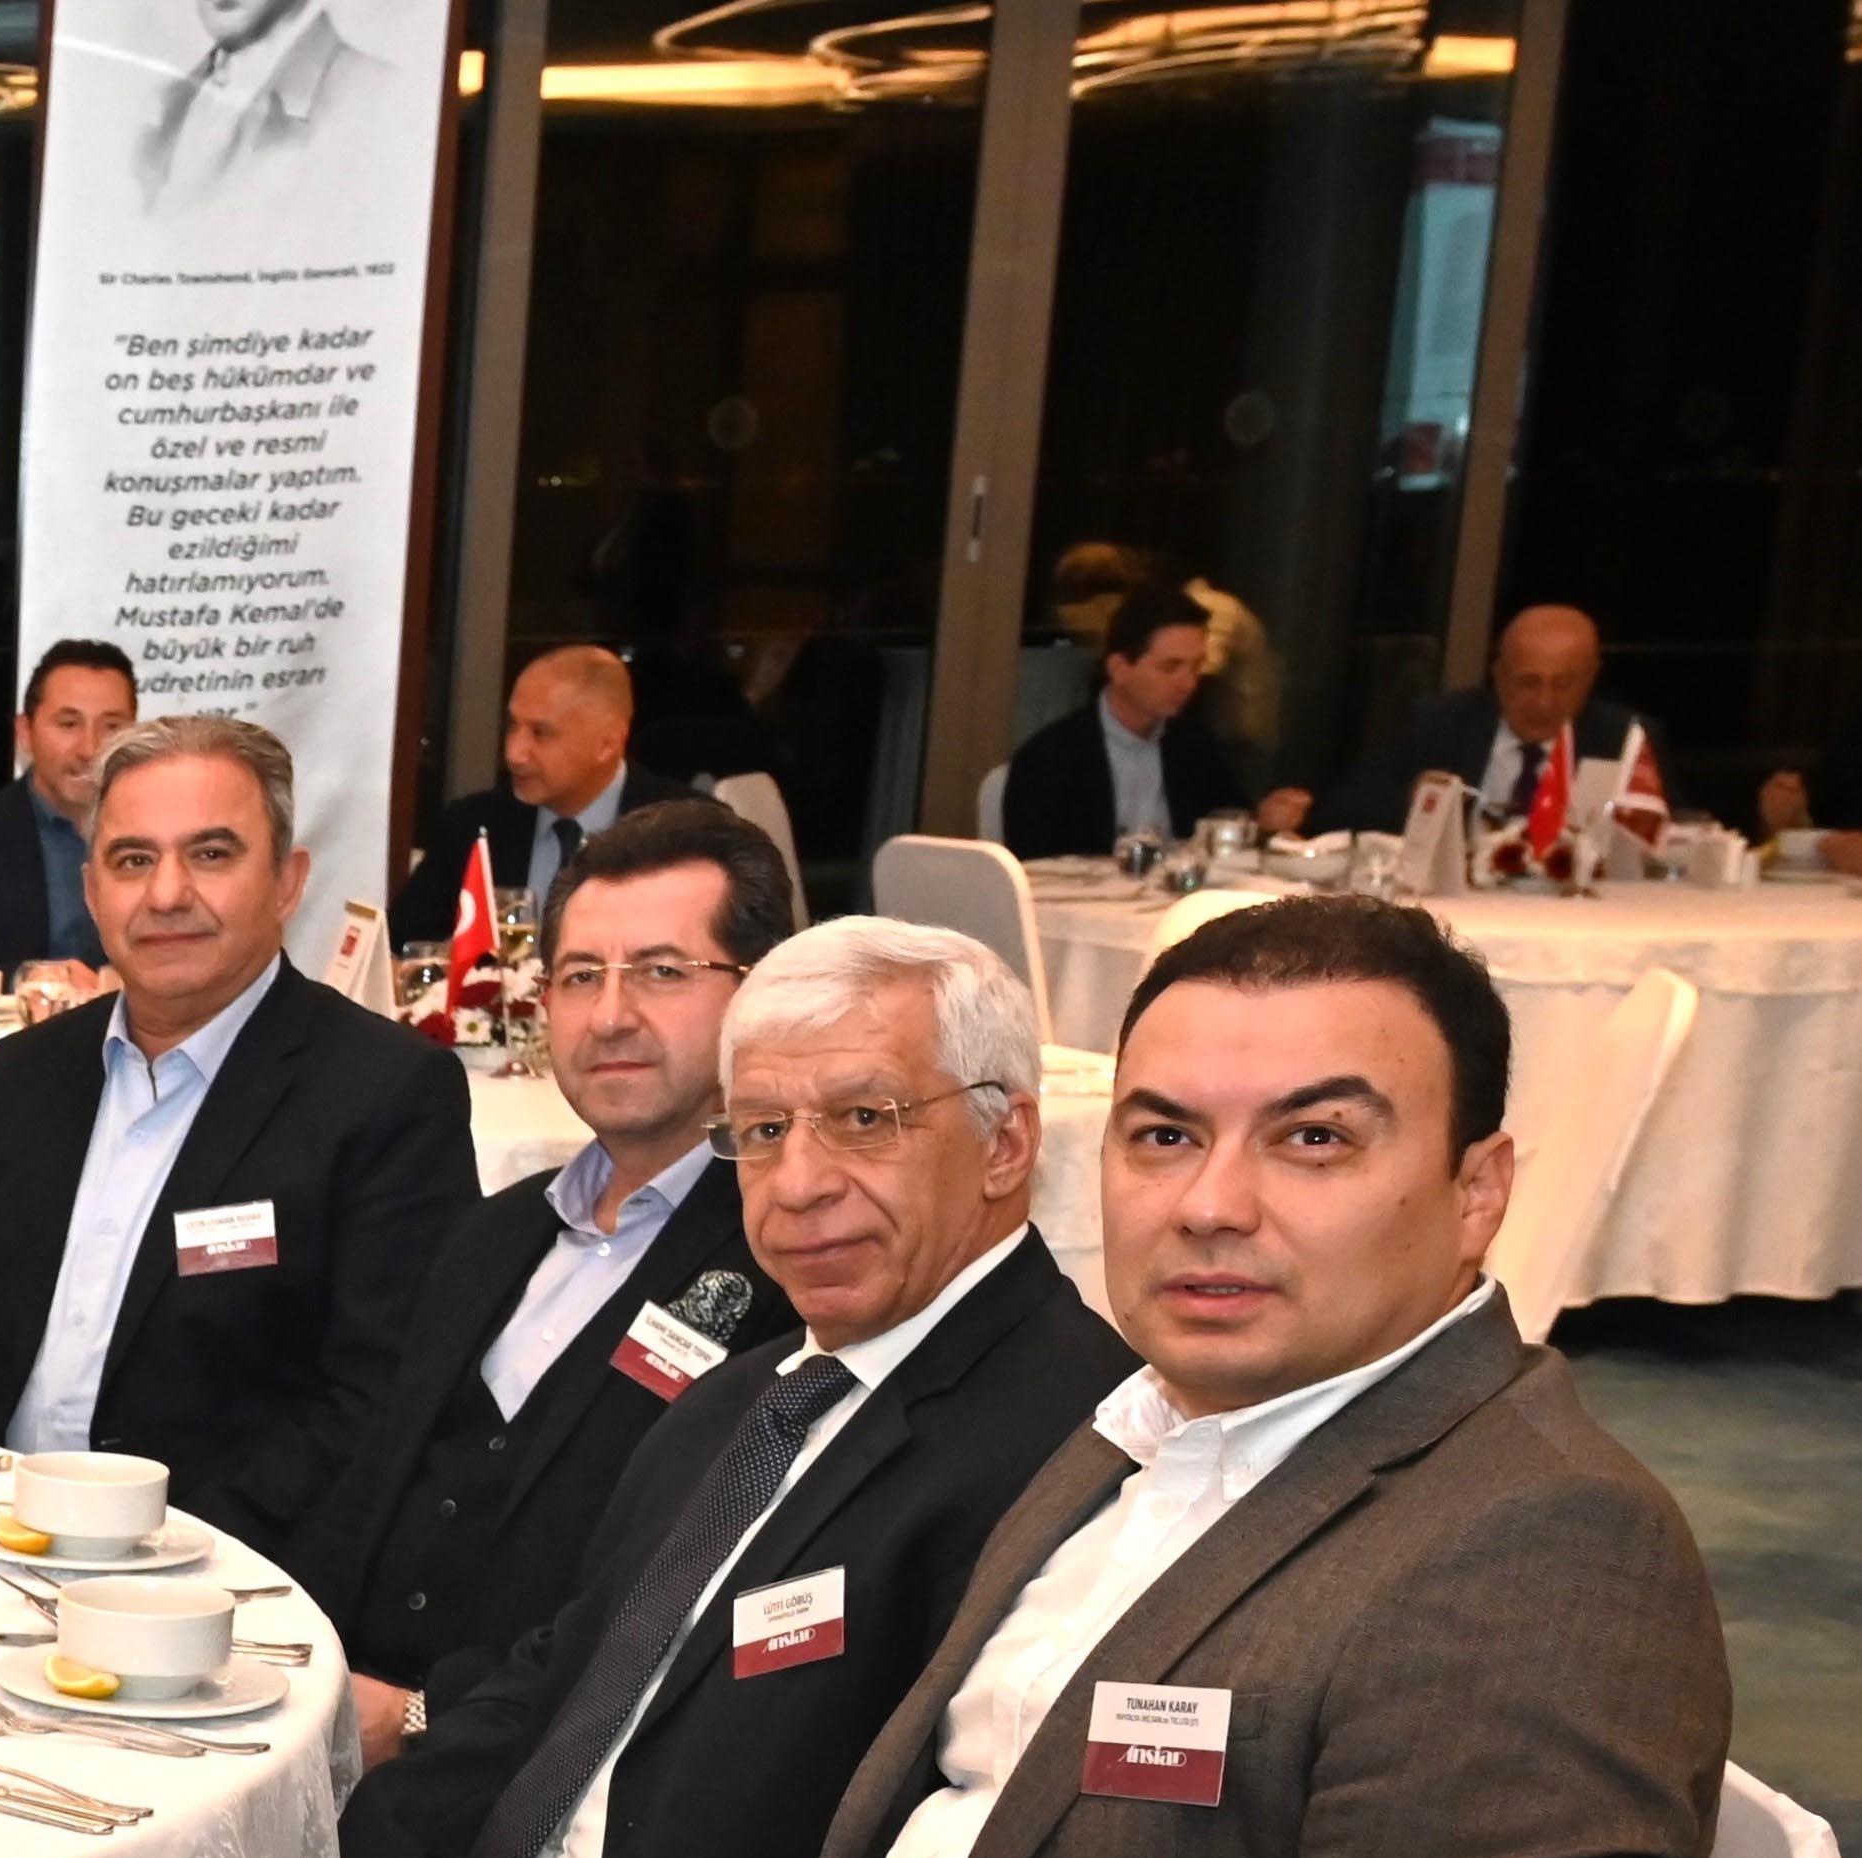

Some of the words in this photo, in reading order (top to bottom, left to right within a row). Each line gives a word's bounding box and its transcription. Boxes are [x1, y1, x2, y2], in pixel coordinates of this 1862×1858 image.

[186, 329, 291, 358] şimdiye
[297, 325, 375, 351] kadar
[104, 372, 139, 391] on
[147, 369, 195, 393] beş
[202, 363, 339, 390] hükümdar
[346, 363, 377, 383] ve
[117, 399, 322, 425] cumhurbaşkanı
[328, 395, 360, 418] ile
[150, 436, 208, 460] özel
[215, 439, 246, 458] ve
[253, 429, 328, 456] resmi
[103, 468, 261, 496] konuşmalar
[267, 465, 362, 493] yaptım.
[125, 504, 164, 527] Bu
[170, 501, 261, 531] geceki
[267, 498, 342, 522] kadar
[167, 532, 301, 562] ezildiğimi
[125, 567, 329, 595] hatırlamıyorum.
[114, 603, 221, 628] Mustafa
[229, 597, 345, 625] Kemal'de
[142, 638, 226, 665] büyük
[233, 635, 272, 658] bir
[277, 632, 316, 655] ruh
[137, 671, 254, 694] udretinin
[1126, 1697, 1167, 1711] TUNAHAN
[1168, 1701, 1199, 1714] KARAY
